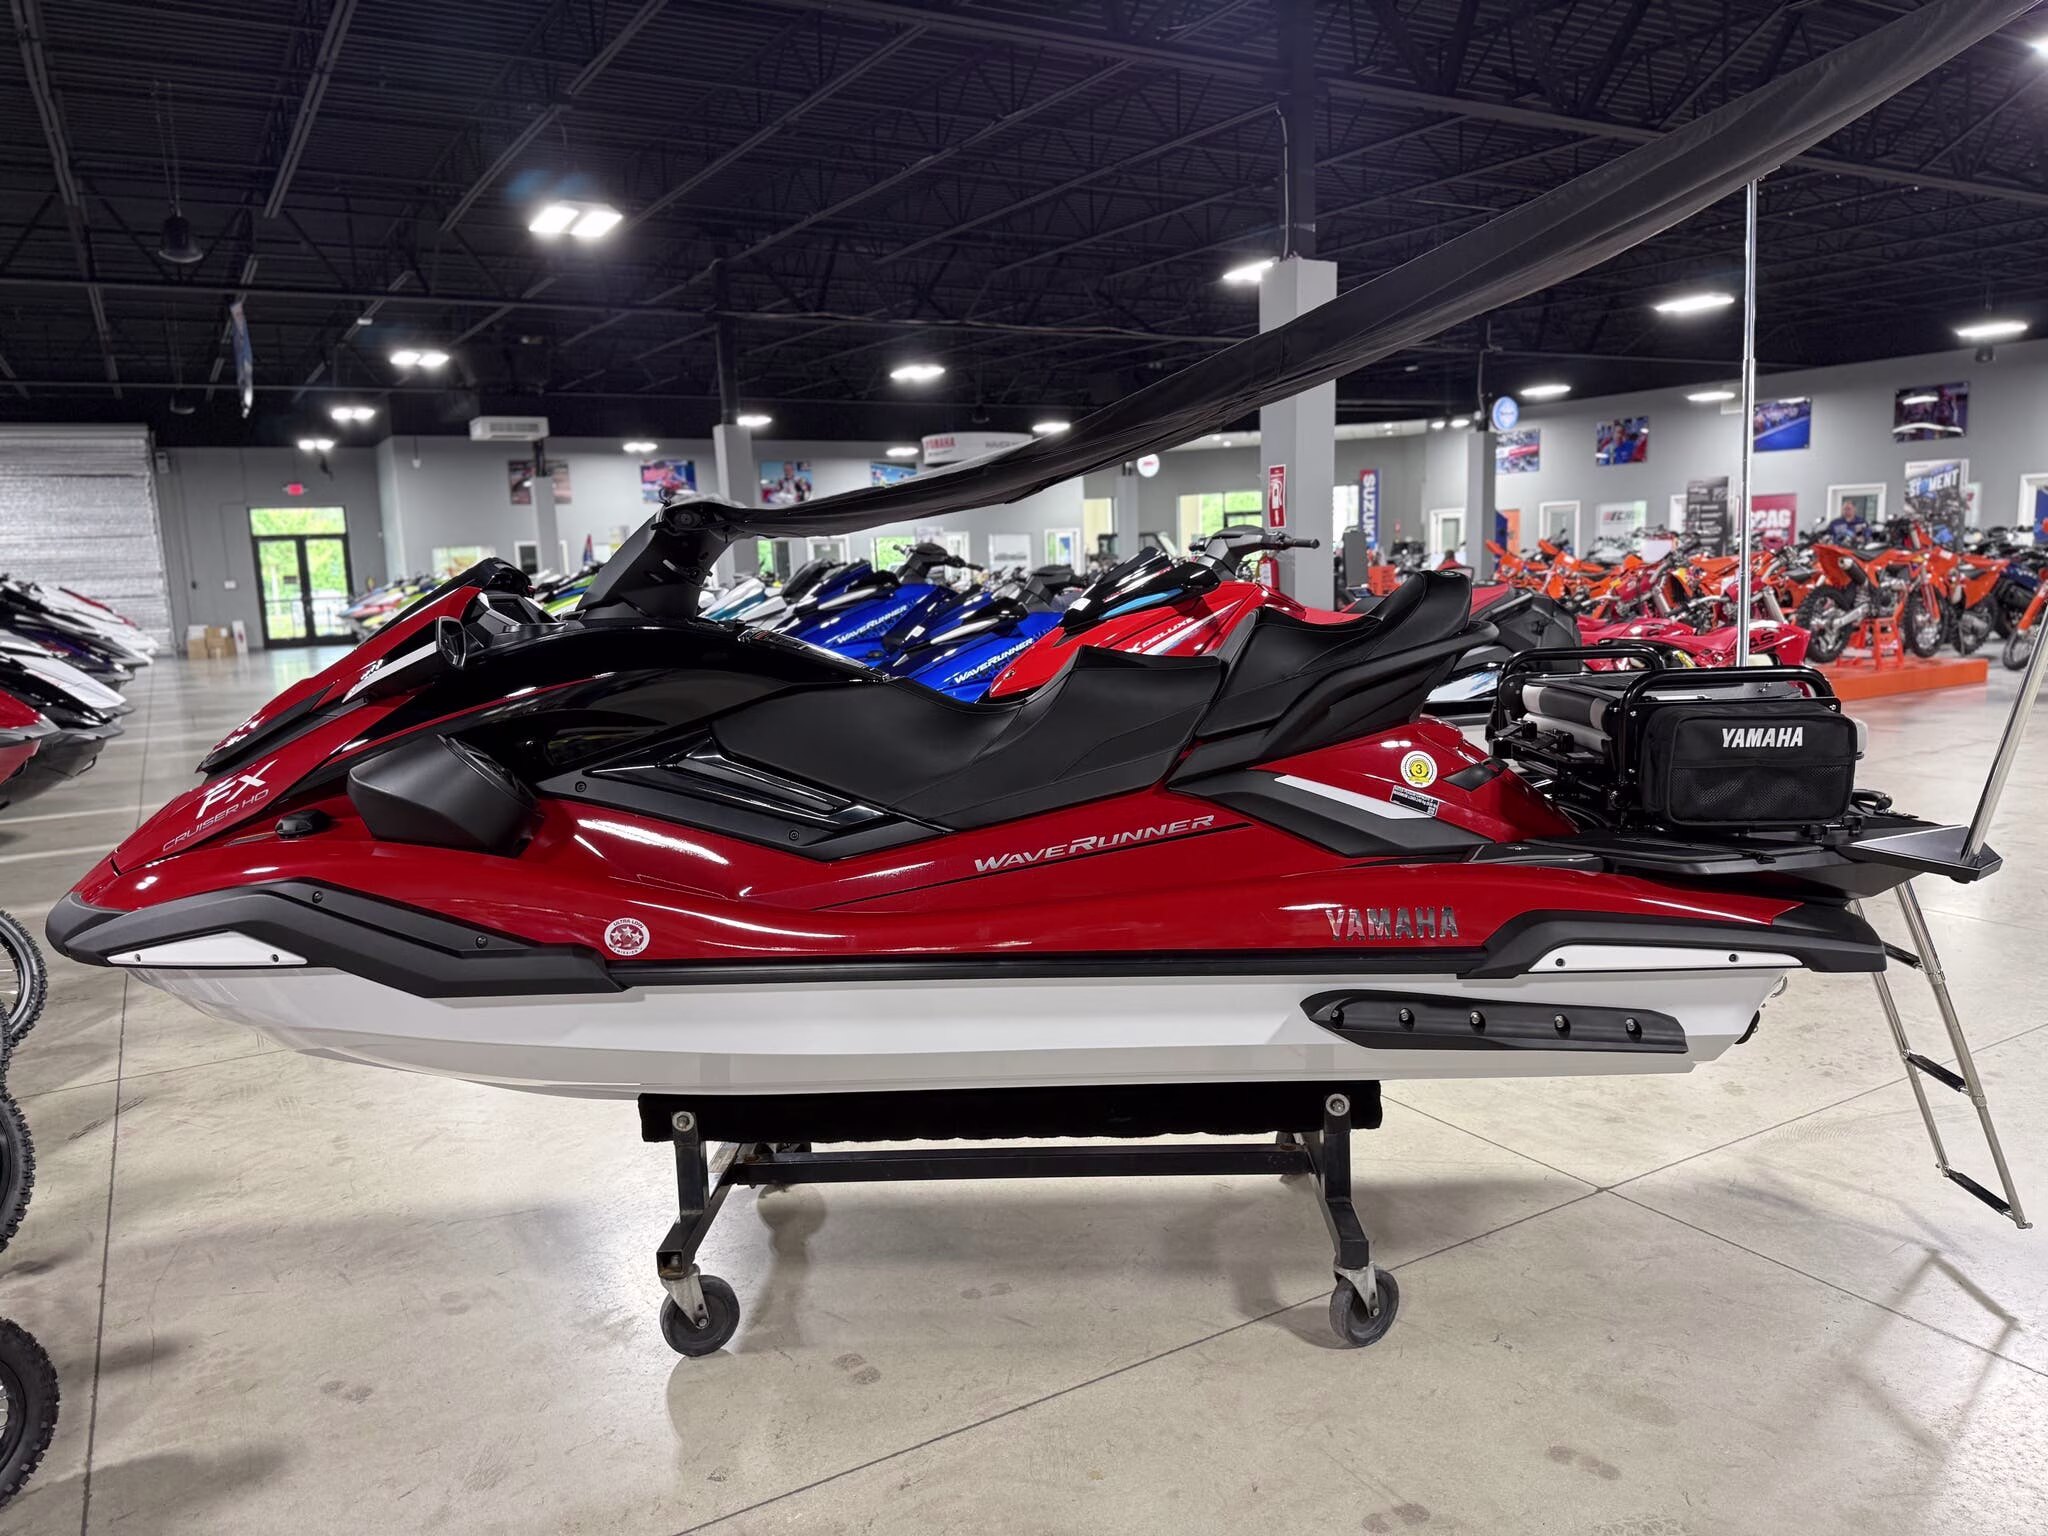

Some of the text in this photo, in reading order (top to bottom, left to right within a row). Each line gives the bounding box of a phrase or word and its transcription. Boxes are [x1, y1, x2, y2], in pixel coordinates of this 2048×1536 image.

[1362, 473, 1377, 543] SUZUKI
[1142, 616, 1195, 648] DELUXE
[953, 637, 1034, 684] WAVERUNNER
[1721, 726, 1804, 749] YAMAHA
[195, 758, 279, 820] FX
[1414, 763, 1423, 775] 3
[162, 788, 270, 852] CRUISER HO
[974, 814, 1215, 872] WAVERUNNER
[1324, 906, 1459, 941] YAMAHA
